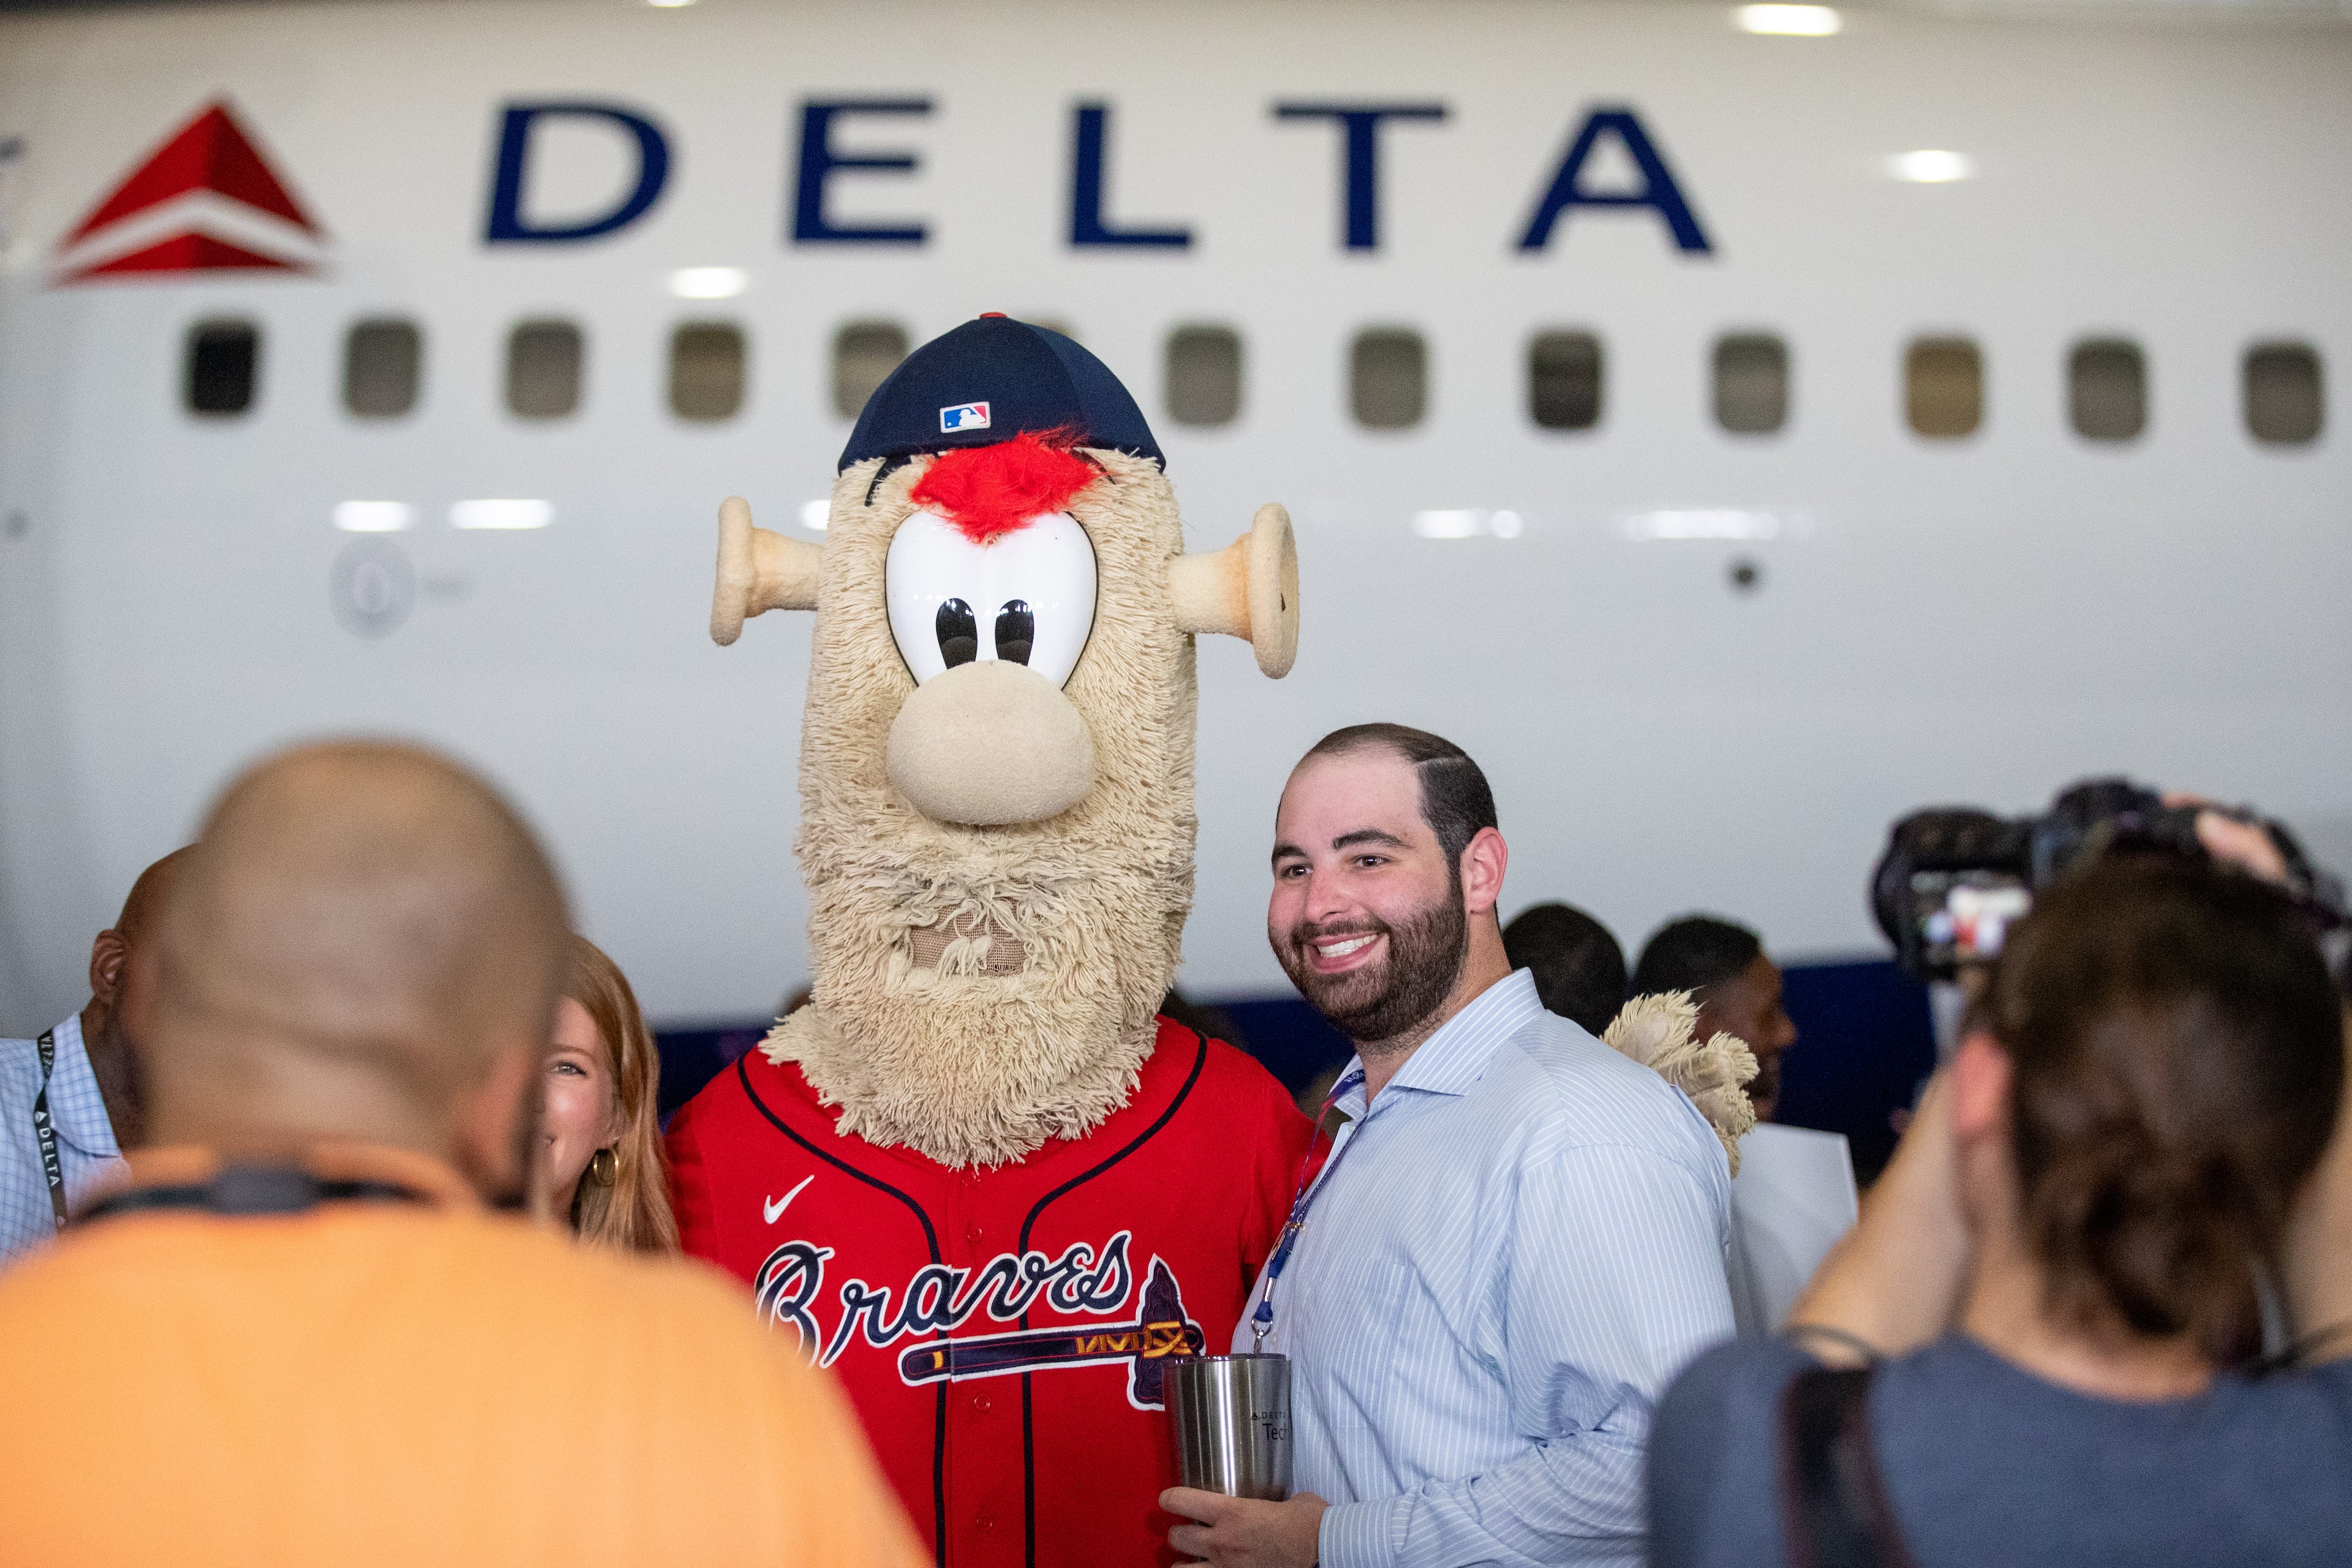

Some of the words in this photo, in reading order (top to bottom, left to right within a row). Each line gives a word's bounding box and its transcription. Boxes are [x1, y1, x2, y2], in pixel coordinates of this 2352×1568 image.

[480, 97, 1719, 257] DELTA
[38, 1127, 61, 1187] DELTA
[754, 1229, 1133, 1370] Braves
